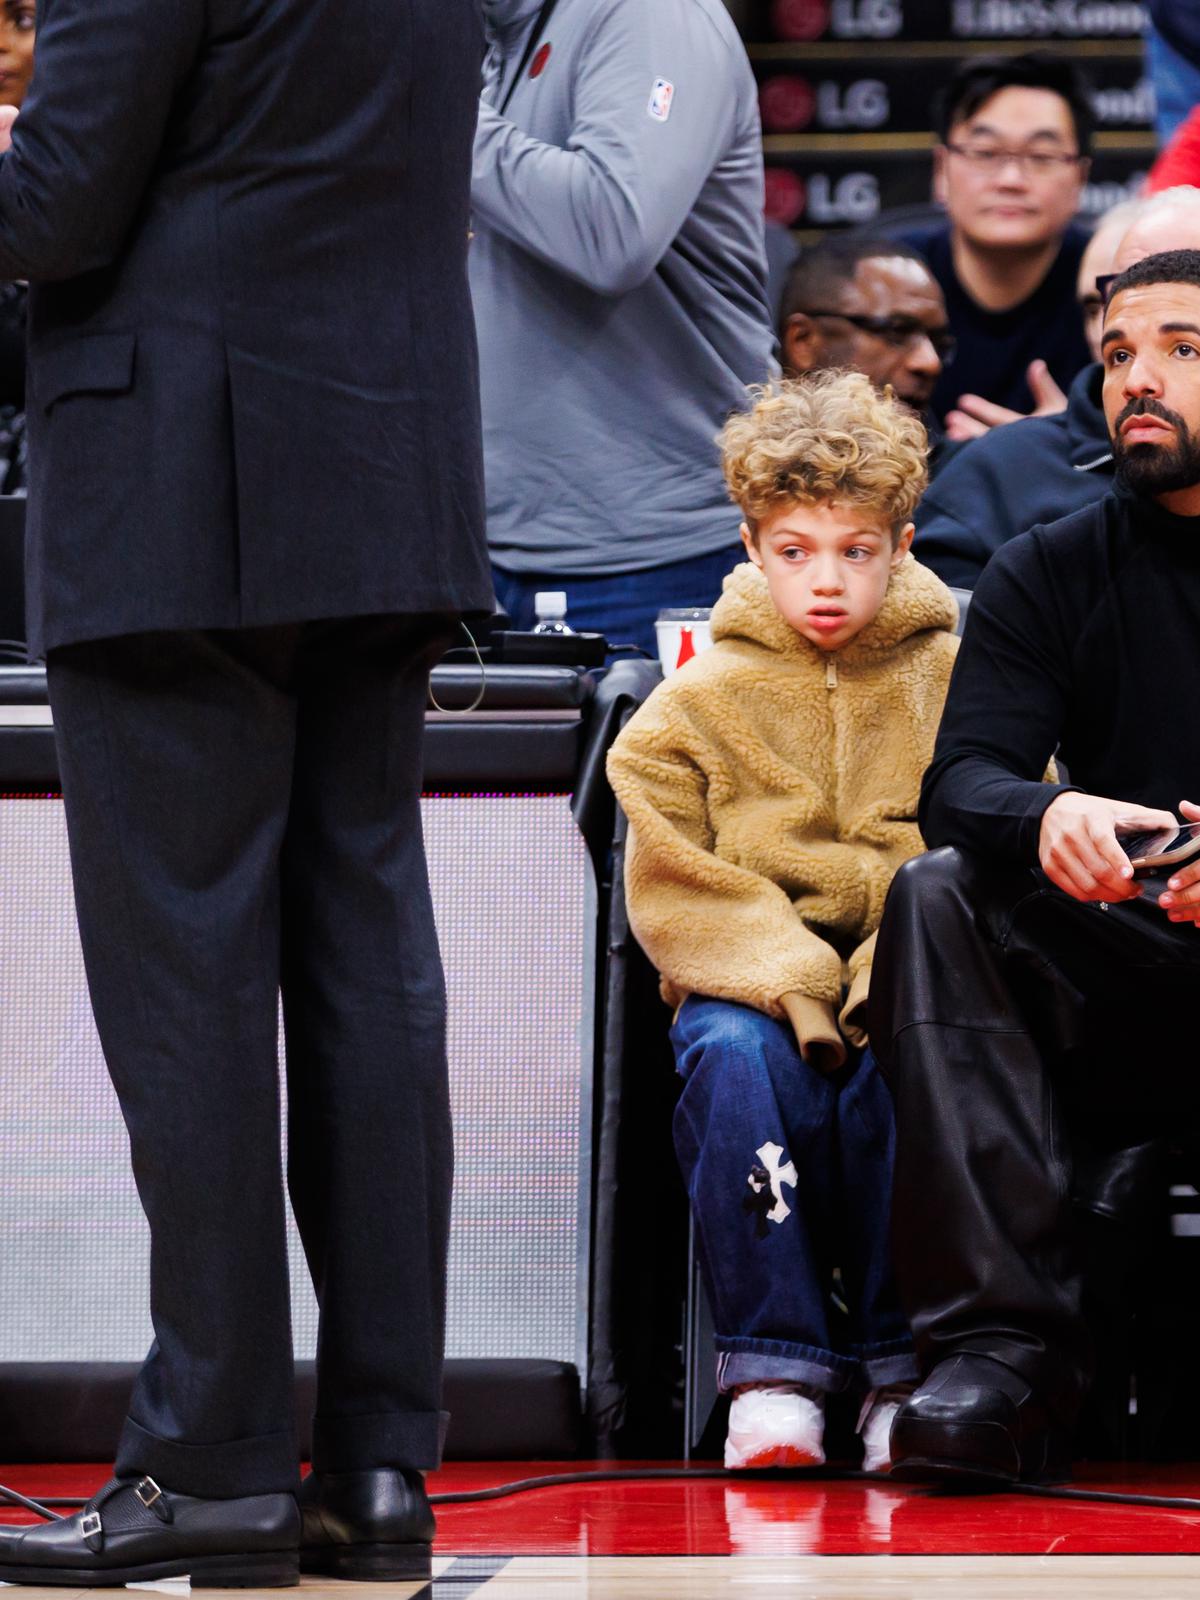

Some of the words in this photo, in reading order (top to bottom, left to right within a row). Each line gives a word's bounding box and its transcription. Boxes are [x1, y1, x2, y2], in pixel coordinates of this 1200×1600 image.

[833, 0, 901, 37] LG
[818, 80, 889, 127] LG
[807, 173, 880, 221] LG
